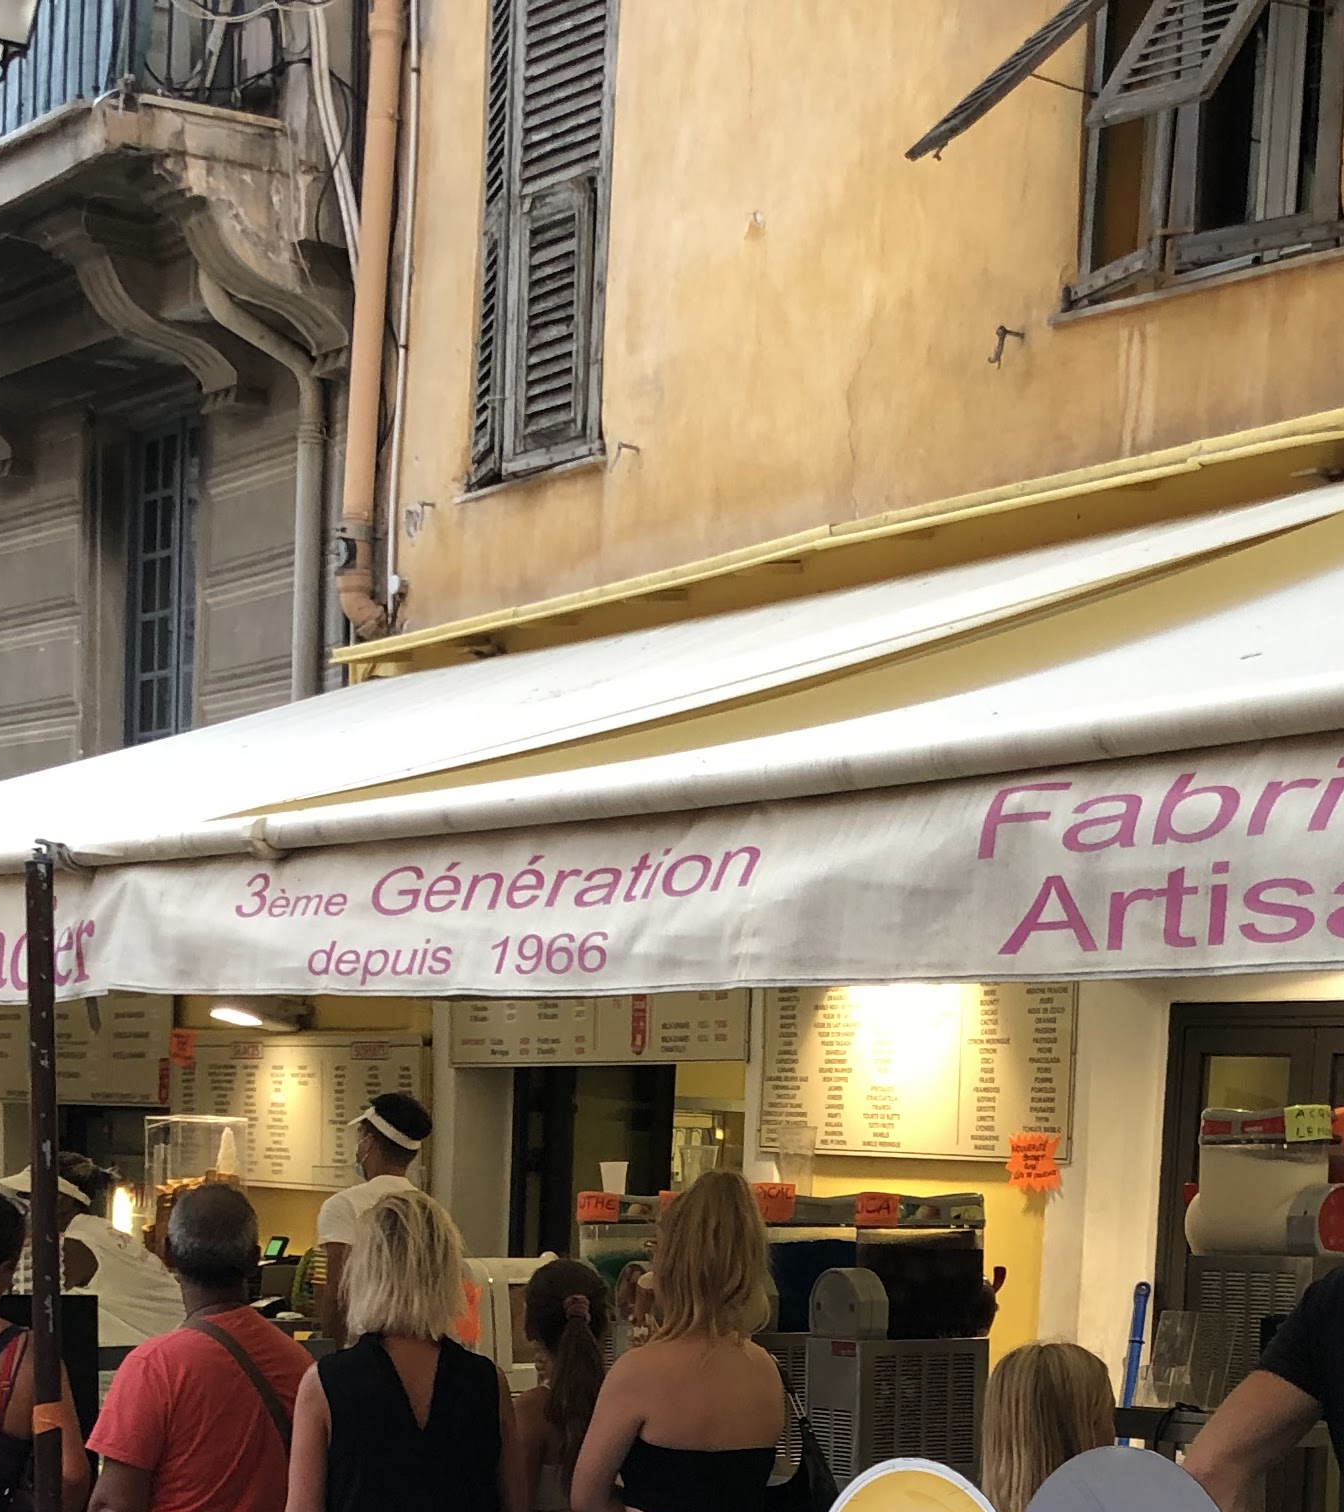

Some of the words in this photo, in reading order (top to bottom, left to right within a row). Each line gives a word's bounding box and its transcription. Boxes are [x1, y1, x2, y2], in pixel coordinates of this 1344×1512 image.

[235, 872, 347, 920] 3ème
[370, 845, 762, 917] Génération
[307, 938, 452, 986] depuis
[489, 931, 609, 976] 1966
